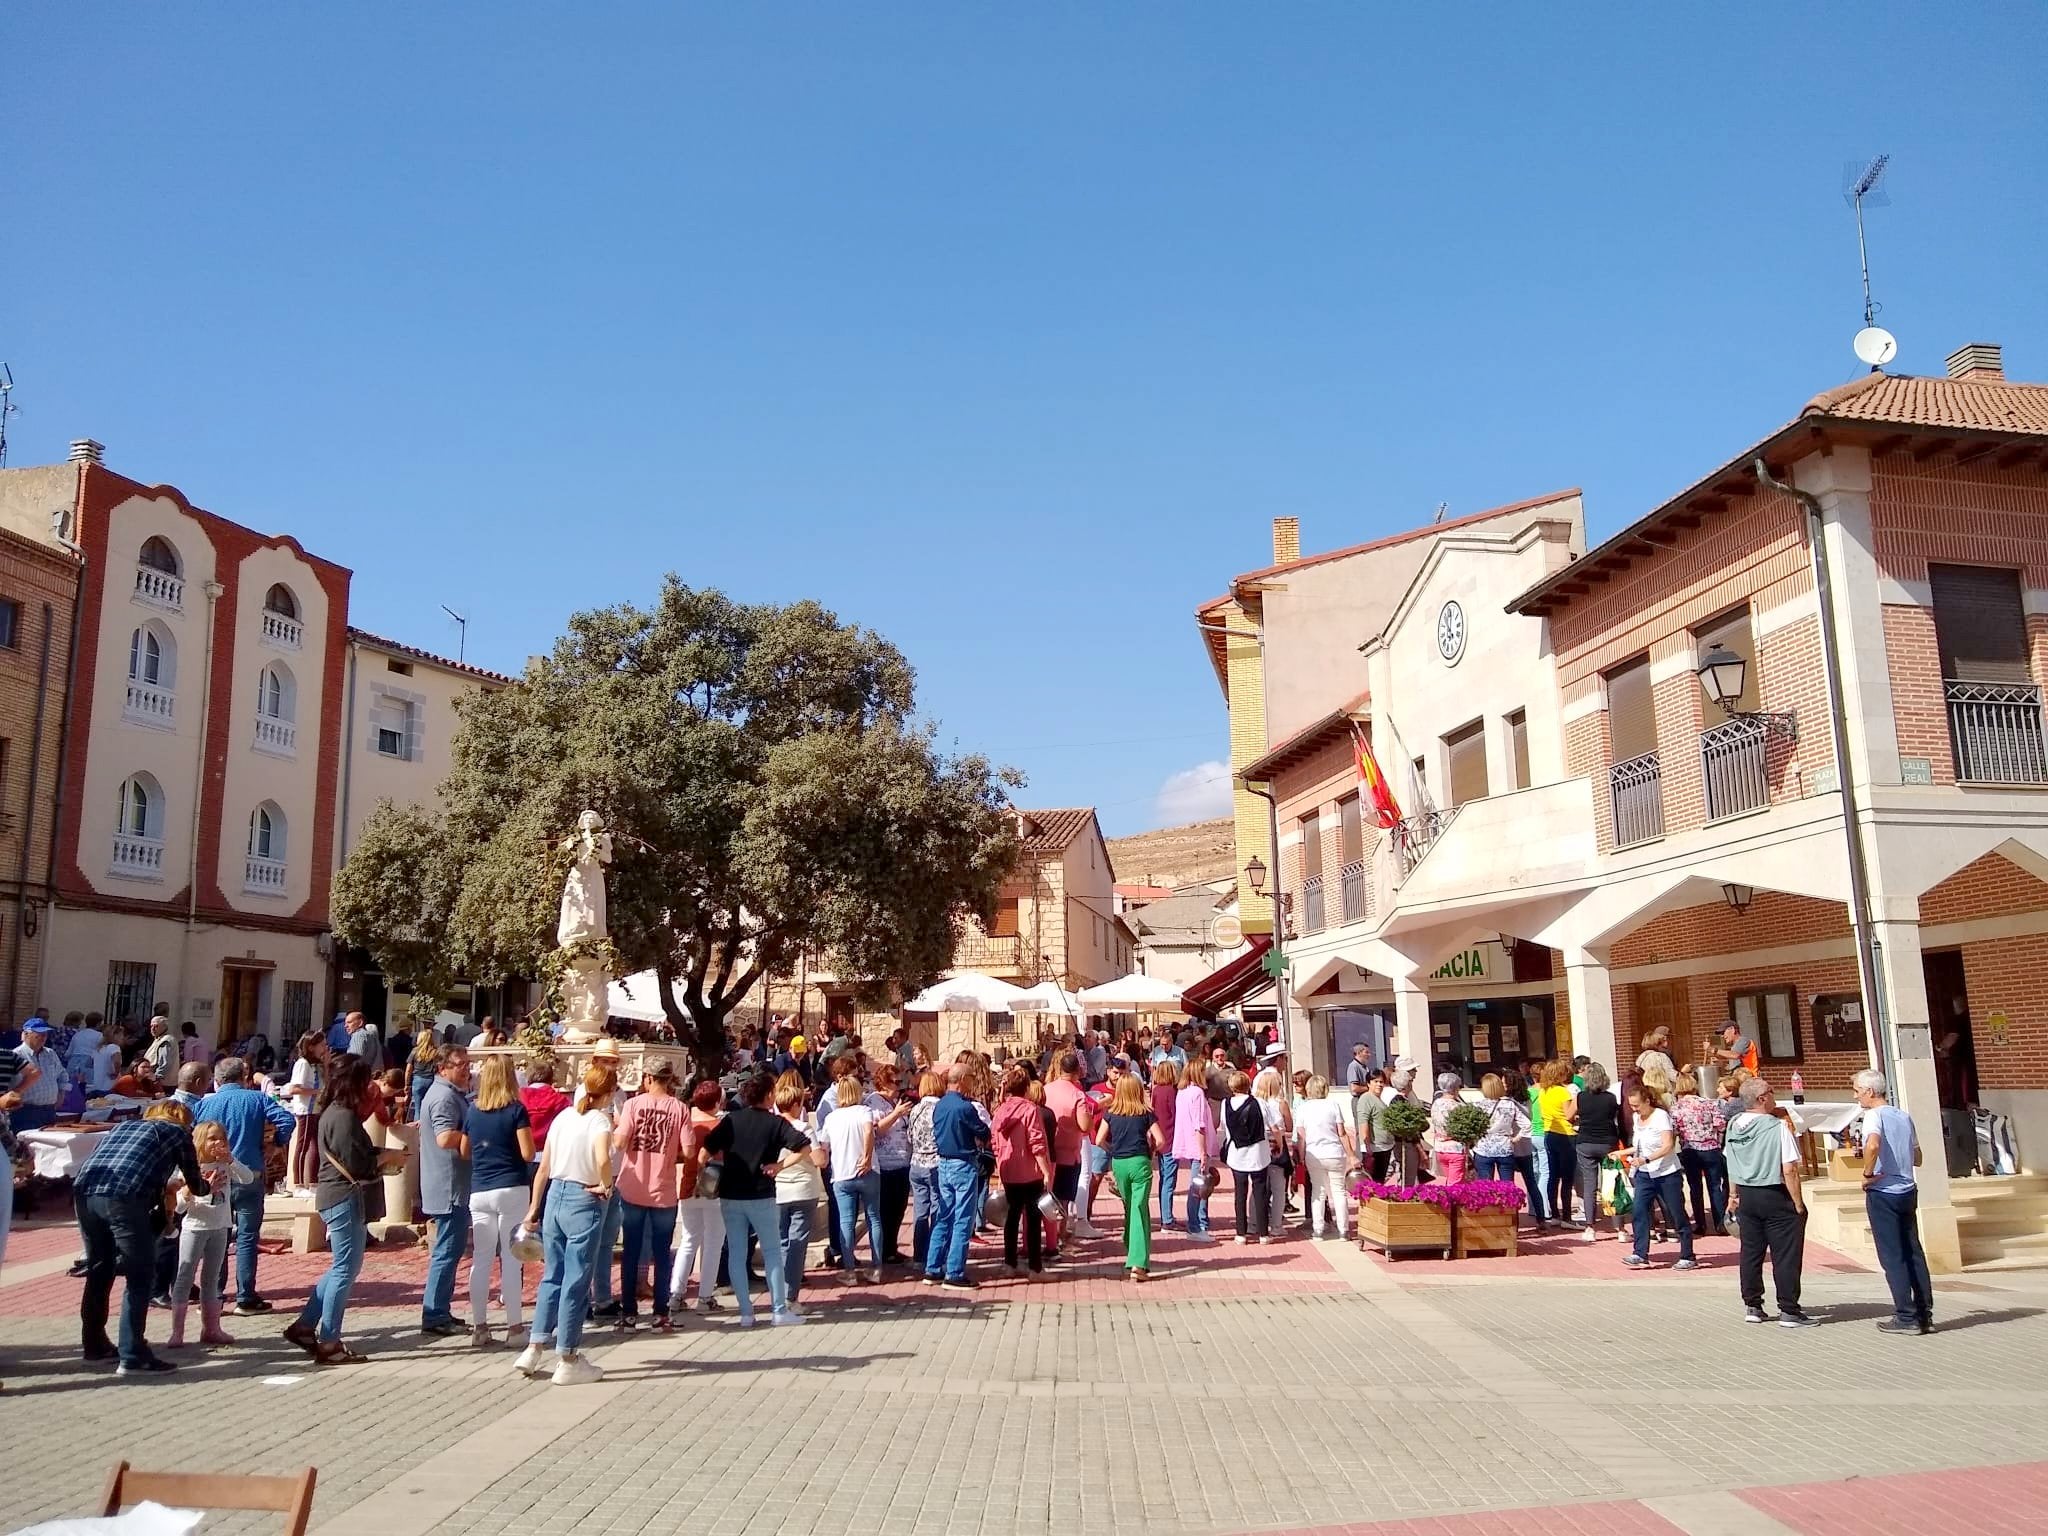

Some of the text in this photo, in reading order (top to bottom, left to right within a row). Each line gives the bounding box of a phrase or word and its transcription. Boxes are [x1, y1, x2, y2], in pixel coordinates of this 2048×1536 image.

[1902, 761, 1927, 771] CALLE
[1815, 769, 1834, 781] PLAZA
[1904, 773, 1929, 783] REAL
[1429, 950, 1484, 978] ACIA
